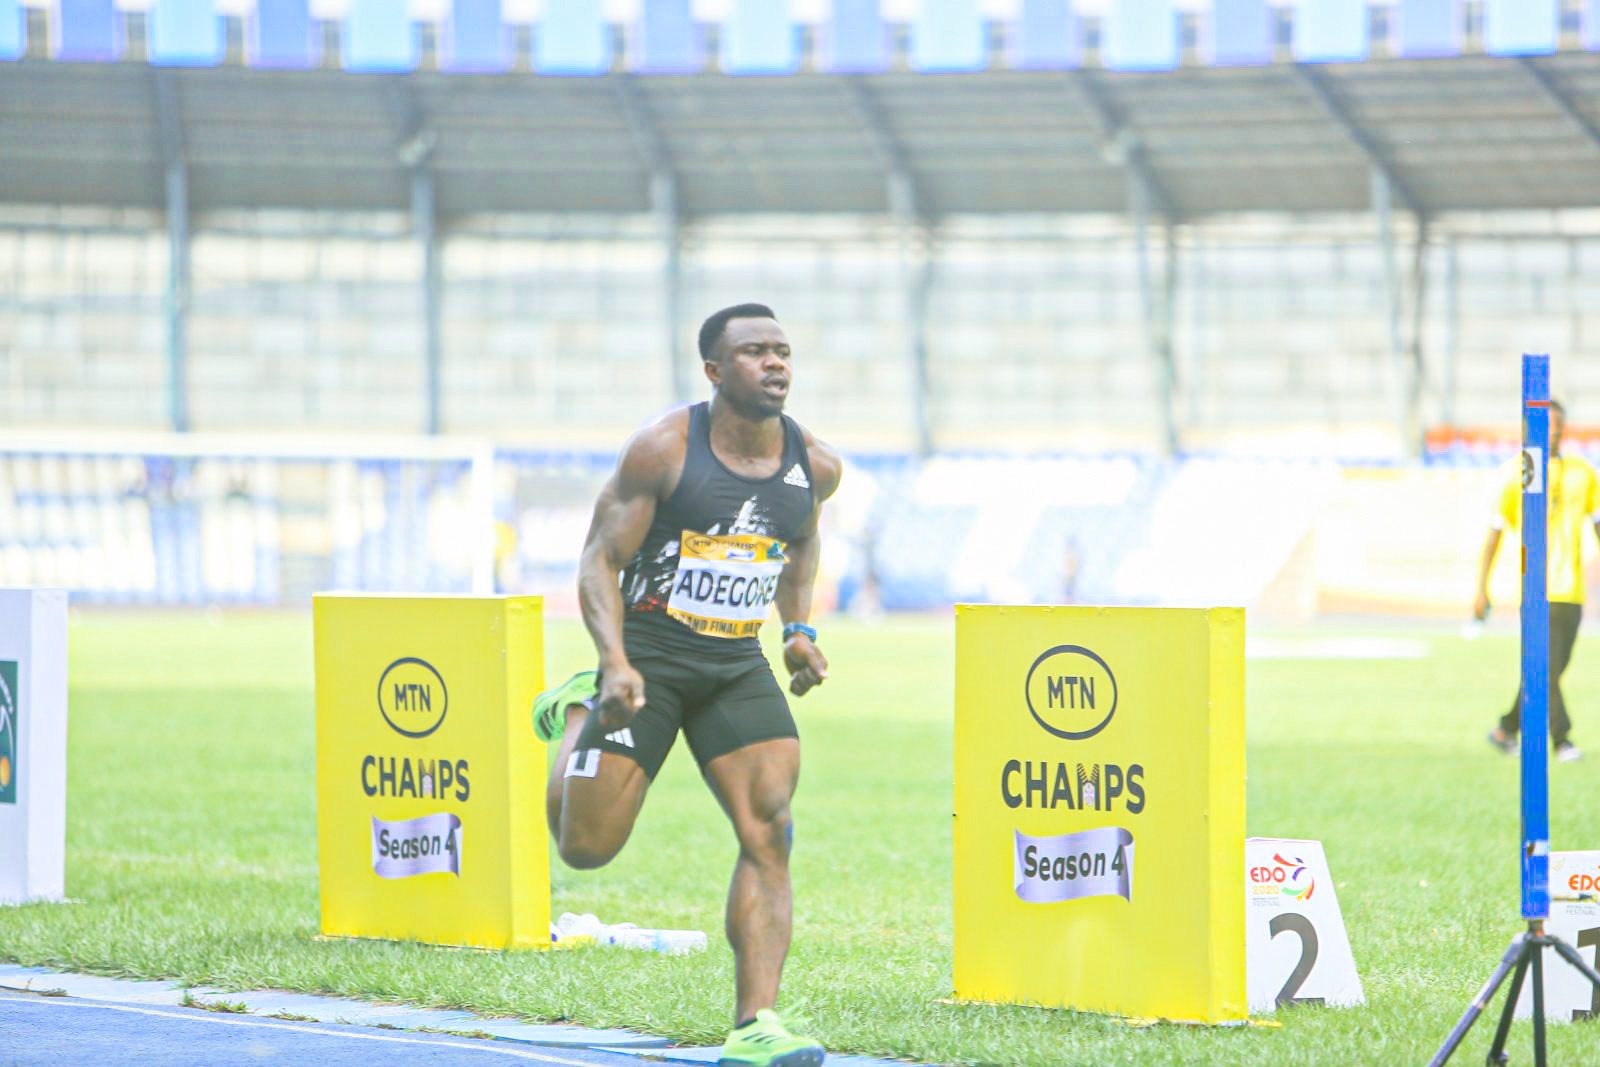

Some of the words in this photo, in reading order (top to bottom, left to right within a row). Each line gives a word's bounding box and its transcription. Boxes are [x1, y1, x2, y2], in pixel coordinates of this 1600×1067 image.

[676, 569, 777, 608] ADEGOKE
[394, 683, 431, 712] MTN
[1047, 675, 1096, 709] MTN
[361, 755, 470, 802] CHAMPS
[1001, 759, 1146, 814] CHAMPS
[379, 829, 441, 859] Season
[445, 828, 455, 855] 4
[1024, 845, 1106, 881] Season
[1111, 844, 1125, 876] 4
[1250, 866, 1286, 883] EDO
[1268, 912, 1325, 1009] 2
